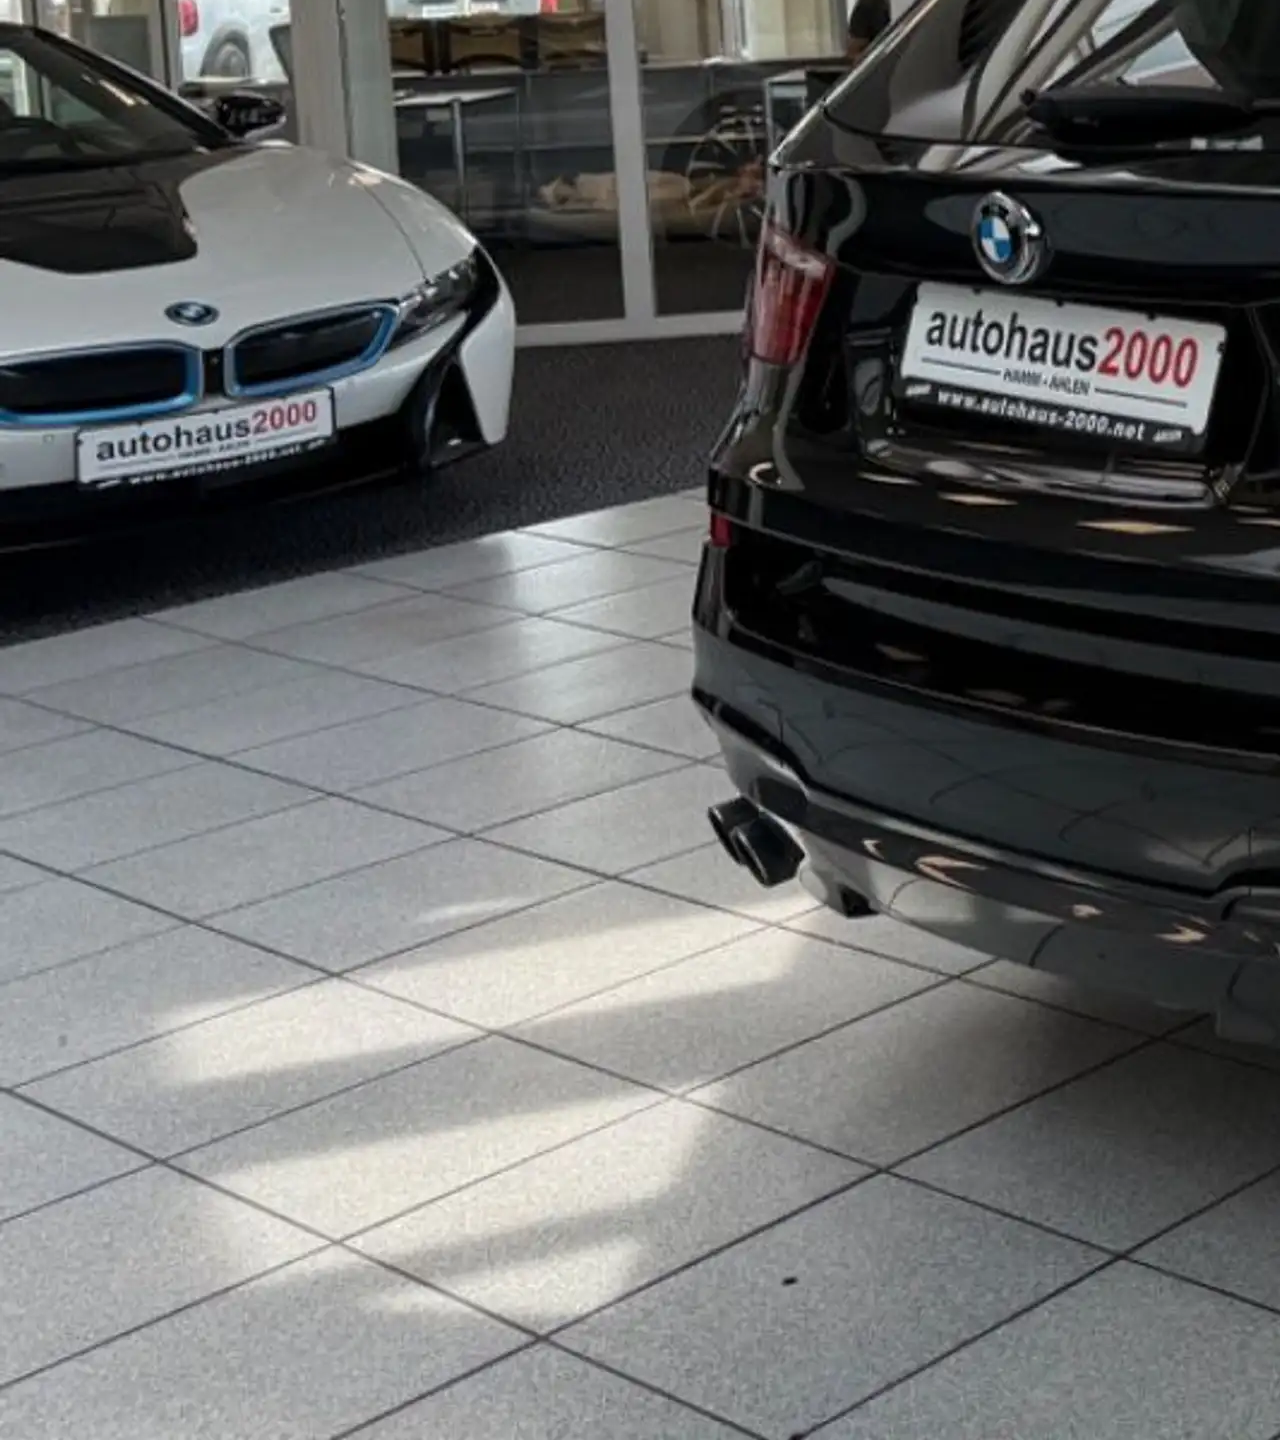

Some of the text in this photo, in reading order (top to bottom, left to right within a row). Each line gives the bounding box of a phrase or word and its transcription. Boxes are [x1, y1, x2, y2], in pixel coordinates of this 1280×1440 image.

[925, 309, 1199, 389] autohaus2000
[95, 400, 317, 462] autohaus2000
[937, 390, 1146, 441] www.autohaus-2000.net
